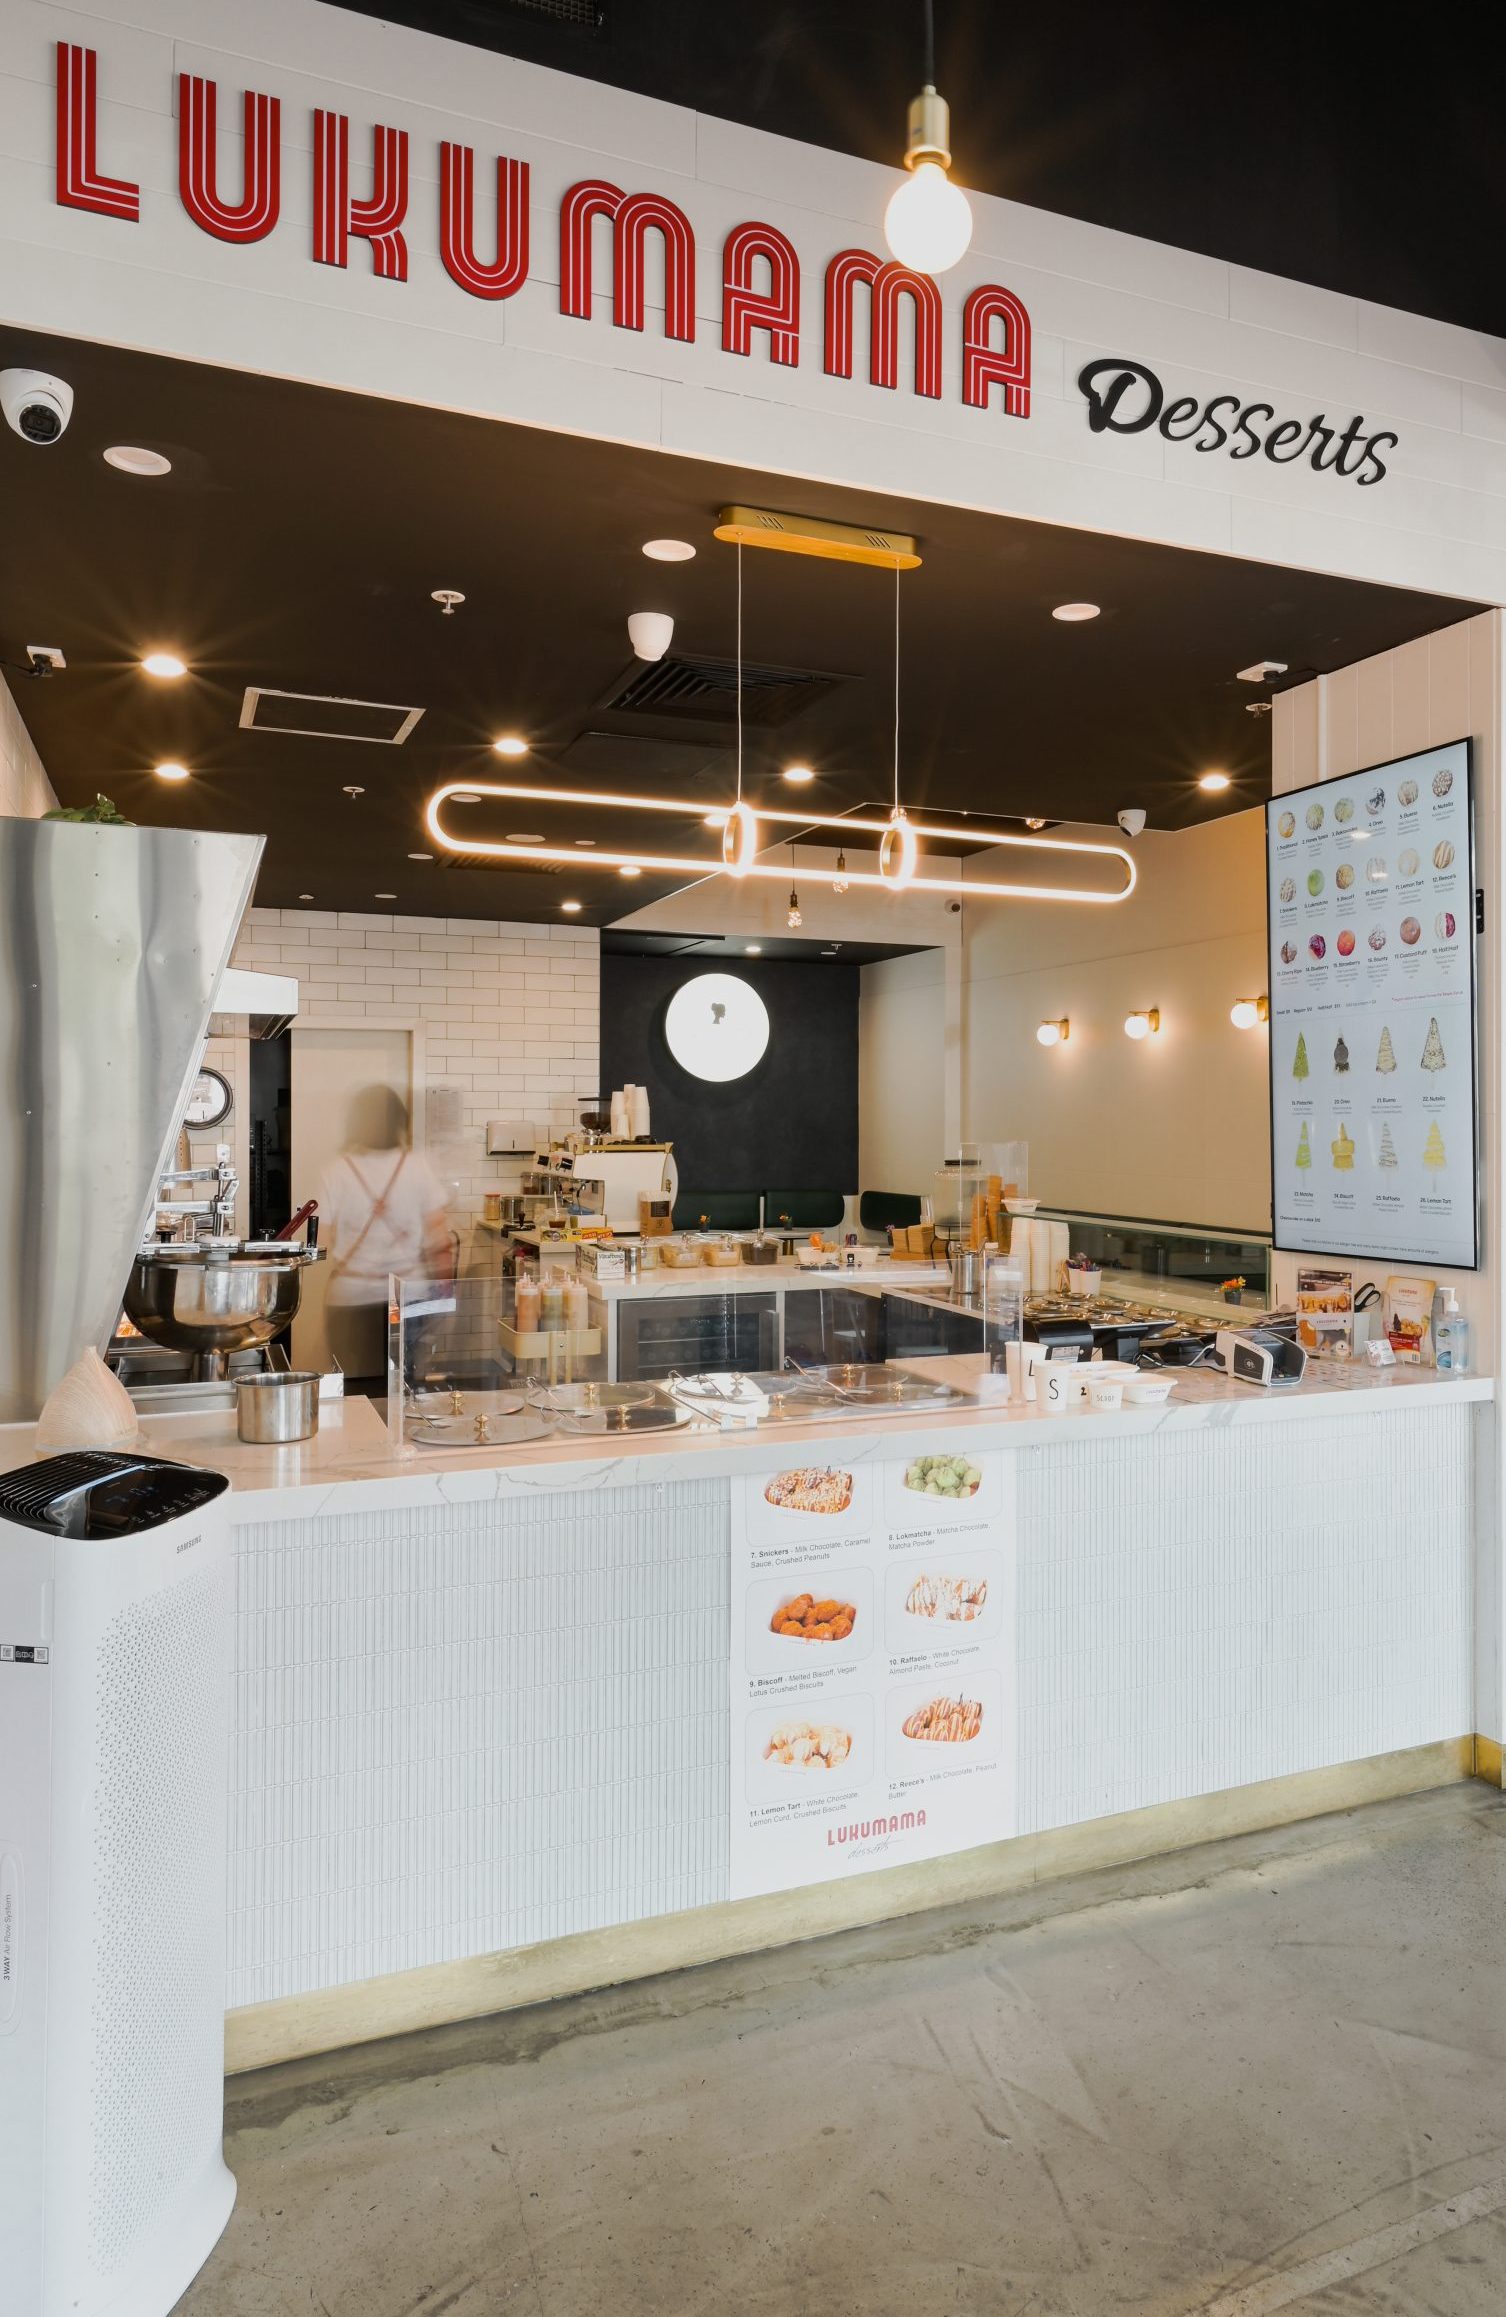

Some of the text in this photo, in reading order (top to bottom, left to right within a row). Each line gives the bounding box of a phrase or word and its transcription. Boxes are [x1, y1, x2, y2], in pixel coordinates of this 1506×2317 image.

[57, 41, 1398, 486] LUKUMAMA Desserts
[1048, 1378, 1060, 1400] S
[897, 1531, 931, 1539] Lokmatcha
[759, 1549, 788, 1557] Snickers
[845, 1538, 870, 1546] Caramel
[776, 1557, 802, 1565] Crushed
[804, 1553, 830, 1561] Peanuts
[758, 1677, 782, 1686] Biscoff
[837, 1666, 856, 1674] Vegan
[750, 1681, 823, 1697] Lotus Crushed Biscuits
[749, 1818, 771, 1827] Lemon
[794, 1809, 820, 1819] Crushed
[823, 1804, 847, 1813] Biscuits
[762, 1806, 785, 1815] Lemon
[827, 1810, 926, 1846] LUKUMAMA
[4, 1894, 13, 1924] System
